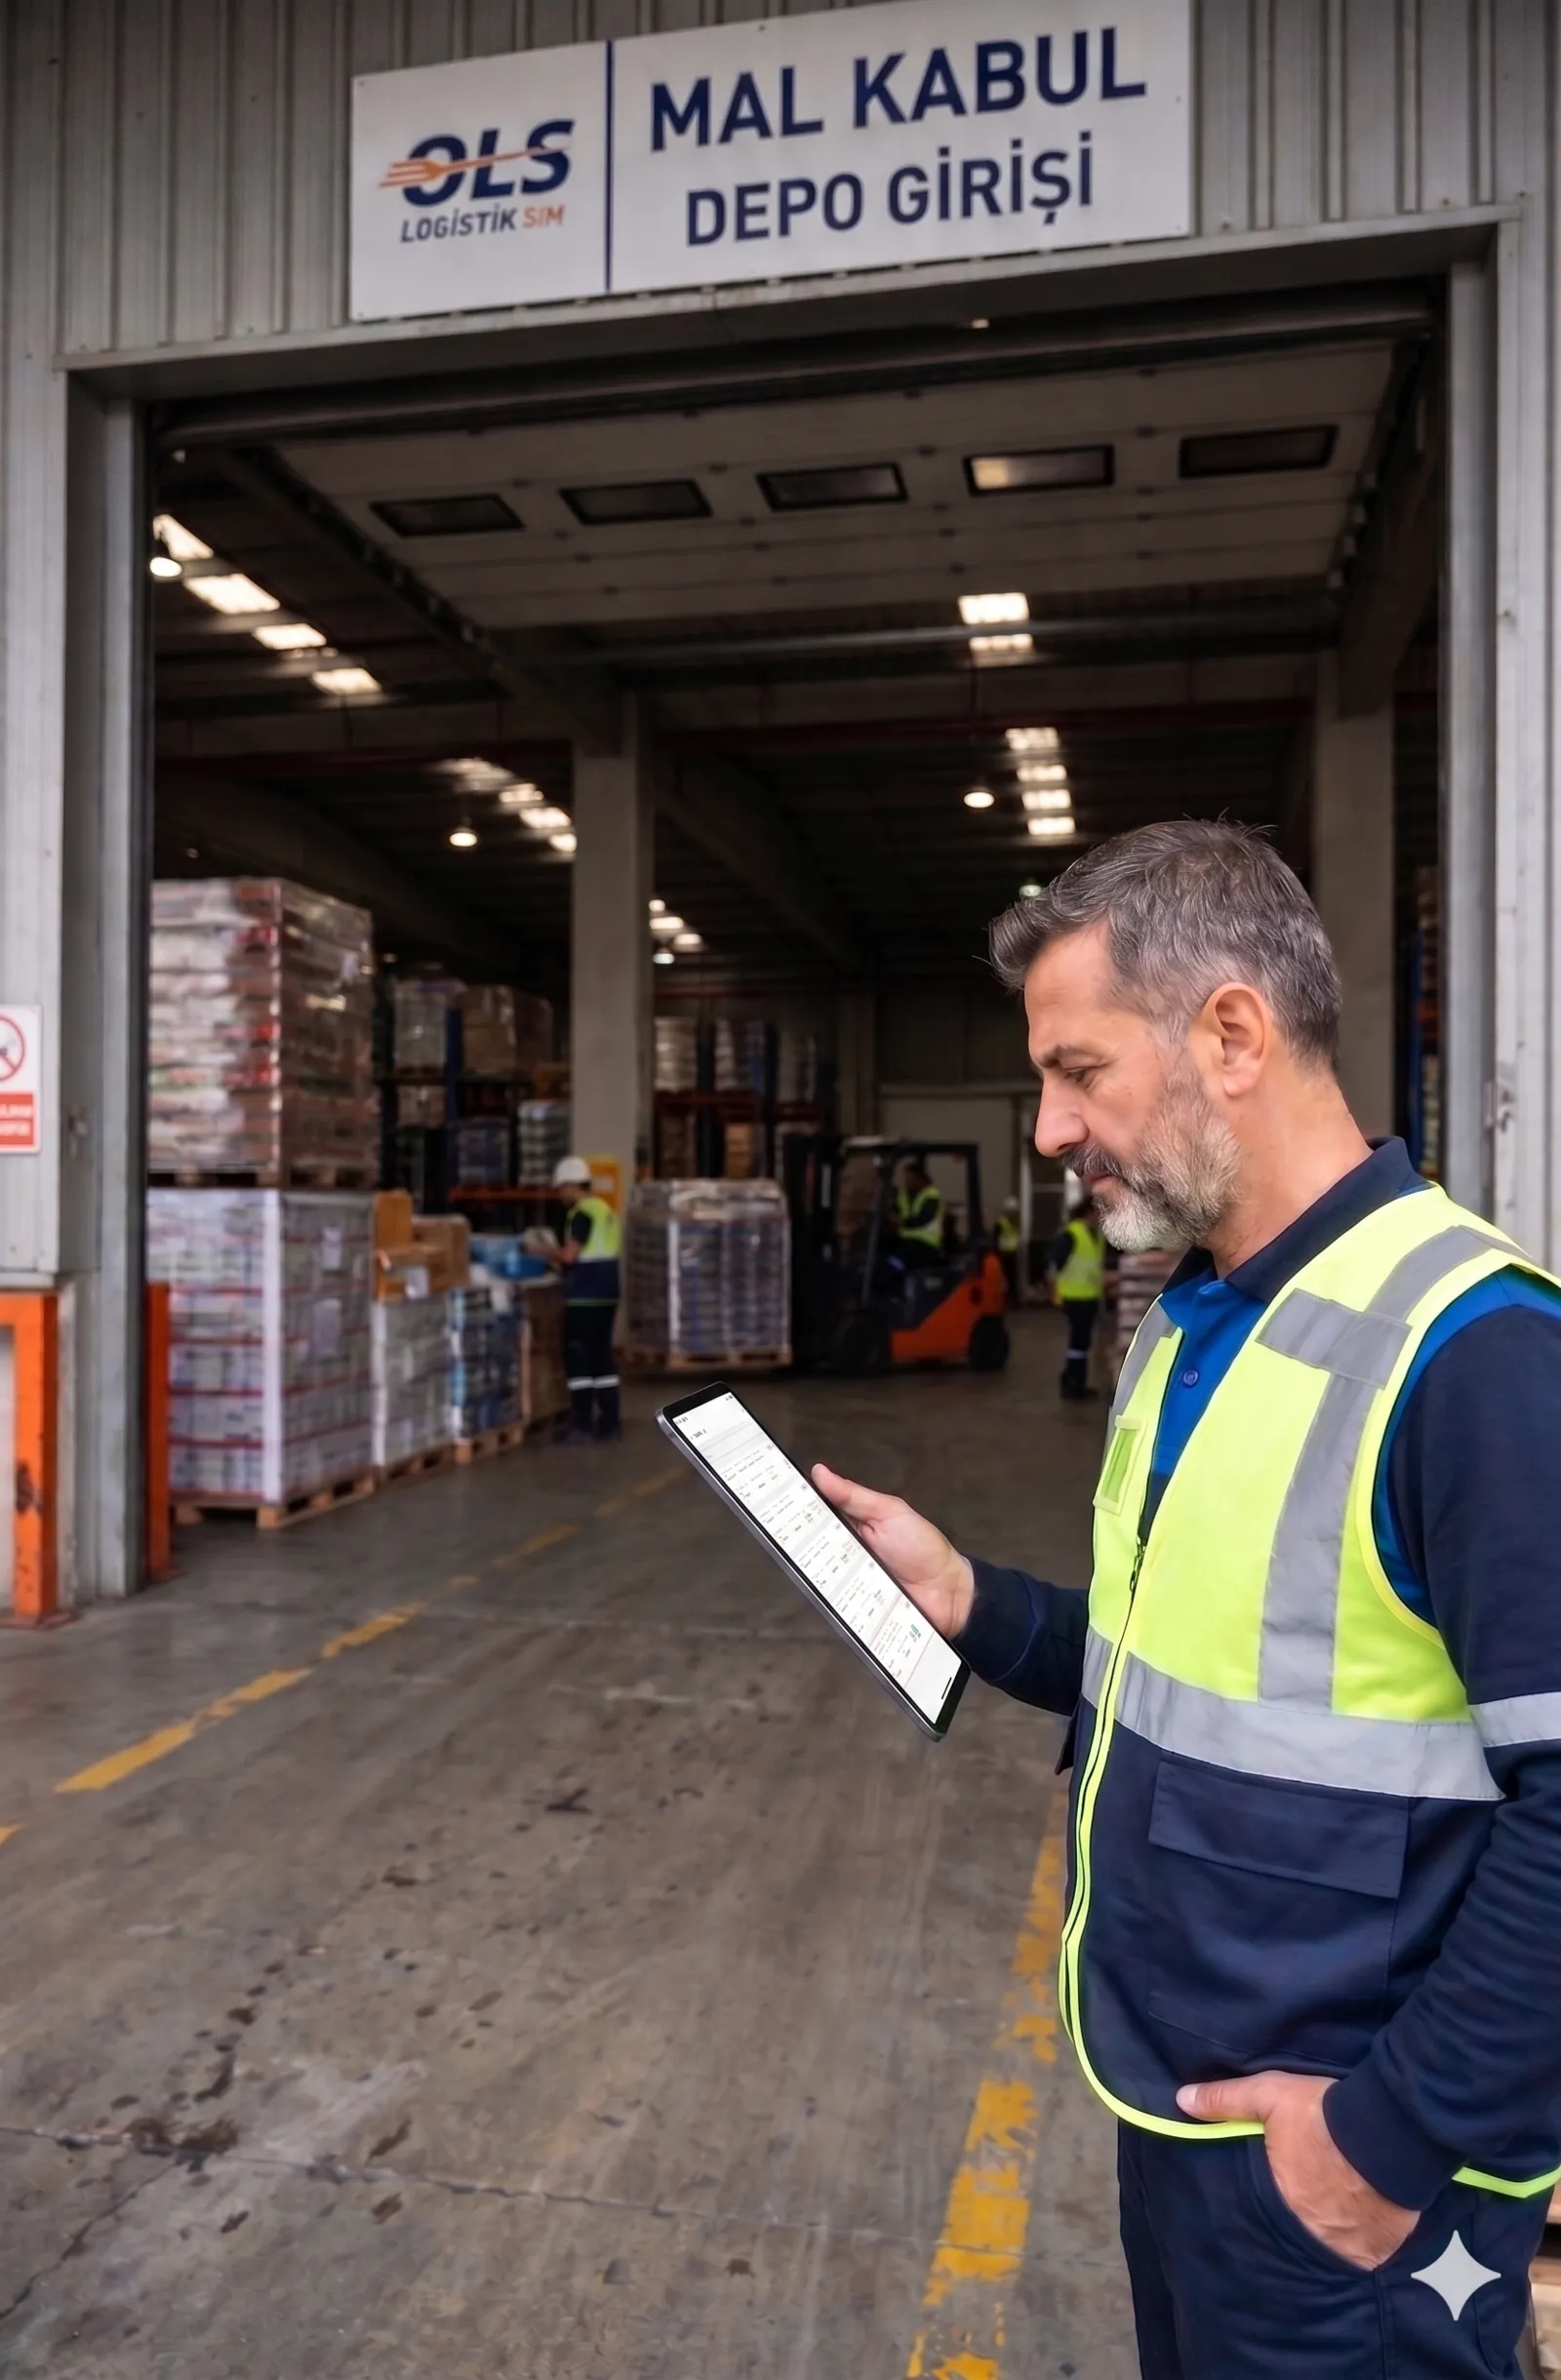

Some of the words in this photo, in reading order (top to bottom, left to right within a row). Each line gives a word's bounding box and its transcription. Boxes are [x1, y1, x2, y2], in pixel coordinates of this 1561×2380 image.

[651, 65, 824, 153] MAL
[853, 25, 1147, 131] KABUL
[402, 118, 576, 208] OLS
[687, 178, 864, 247] DEPO
[888, 130, 1092, 225] GİRİŞİ
[400, 203, 519, 244] LOGİSTİK
